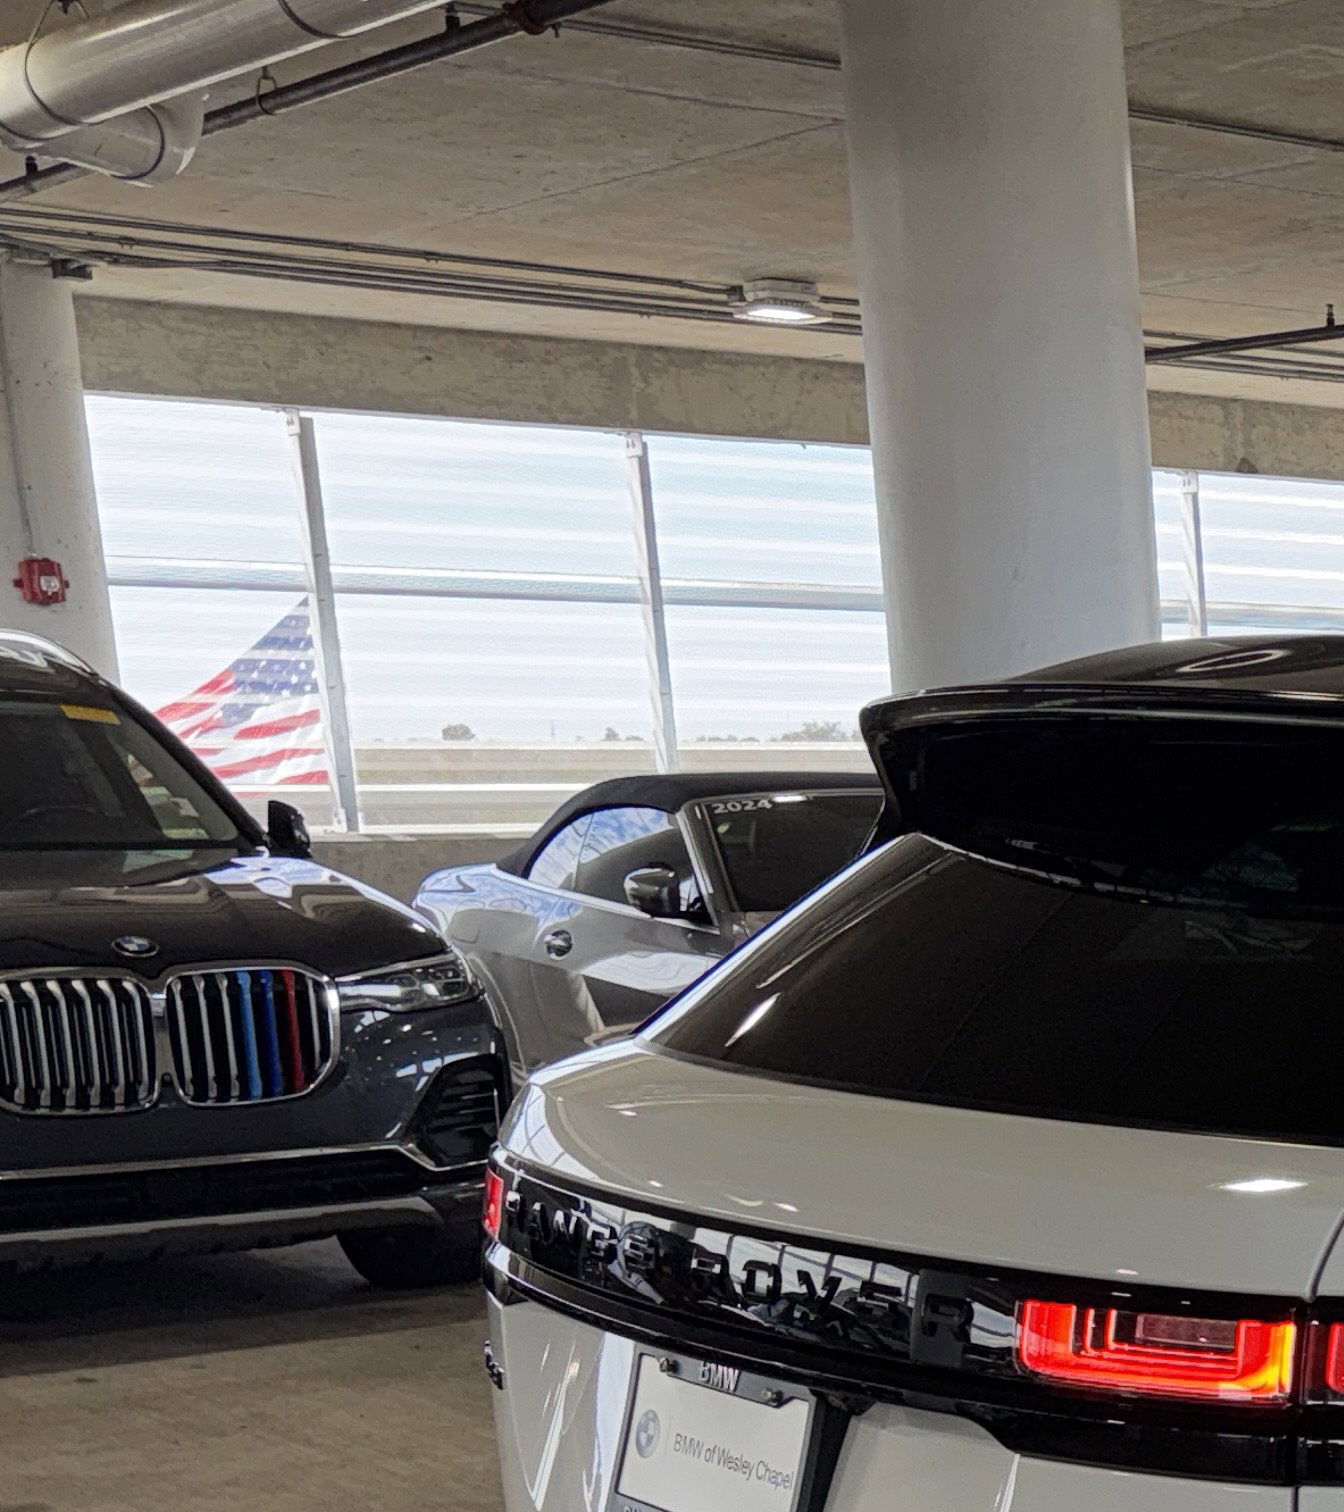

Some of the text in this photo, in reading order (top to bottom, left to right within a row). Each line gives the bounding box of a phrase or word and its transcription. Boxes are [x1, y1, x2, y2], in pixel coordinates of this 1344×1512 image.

[712, 799, 773, 814] 2024
[505, 1190, 975, 1343] RANGE ROVER
[701, 1361, 740, 1392] BMW
[672, 1432, 794, 1491] BMW of Wesley Chapel
